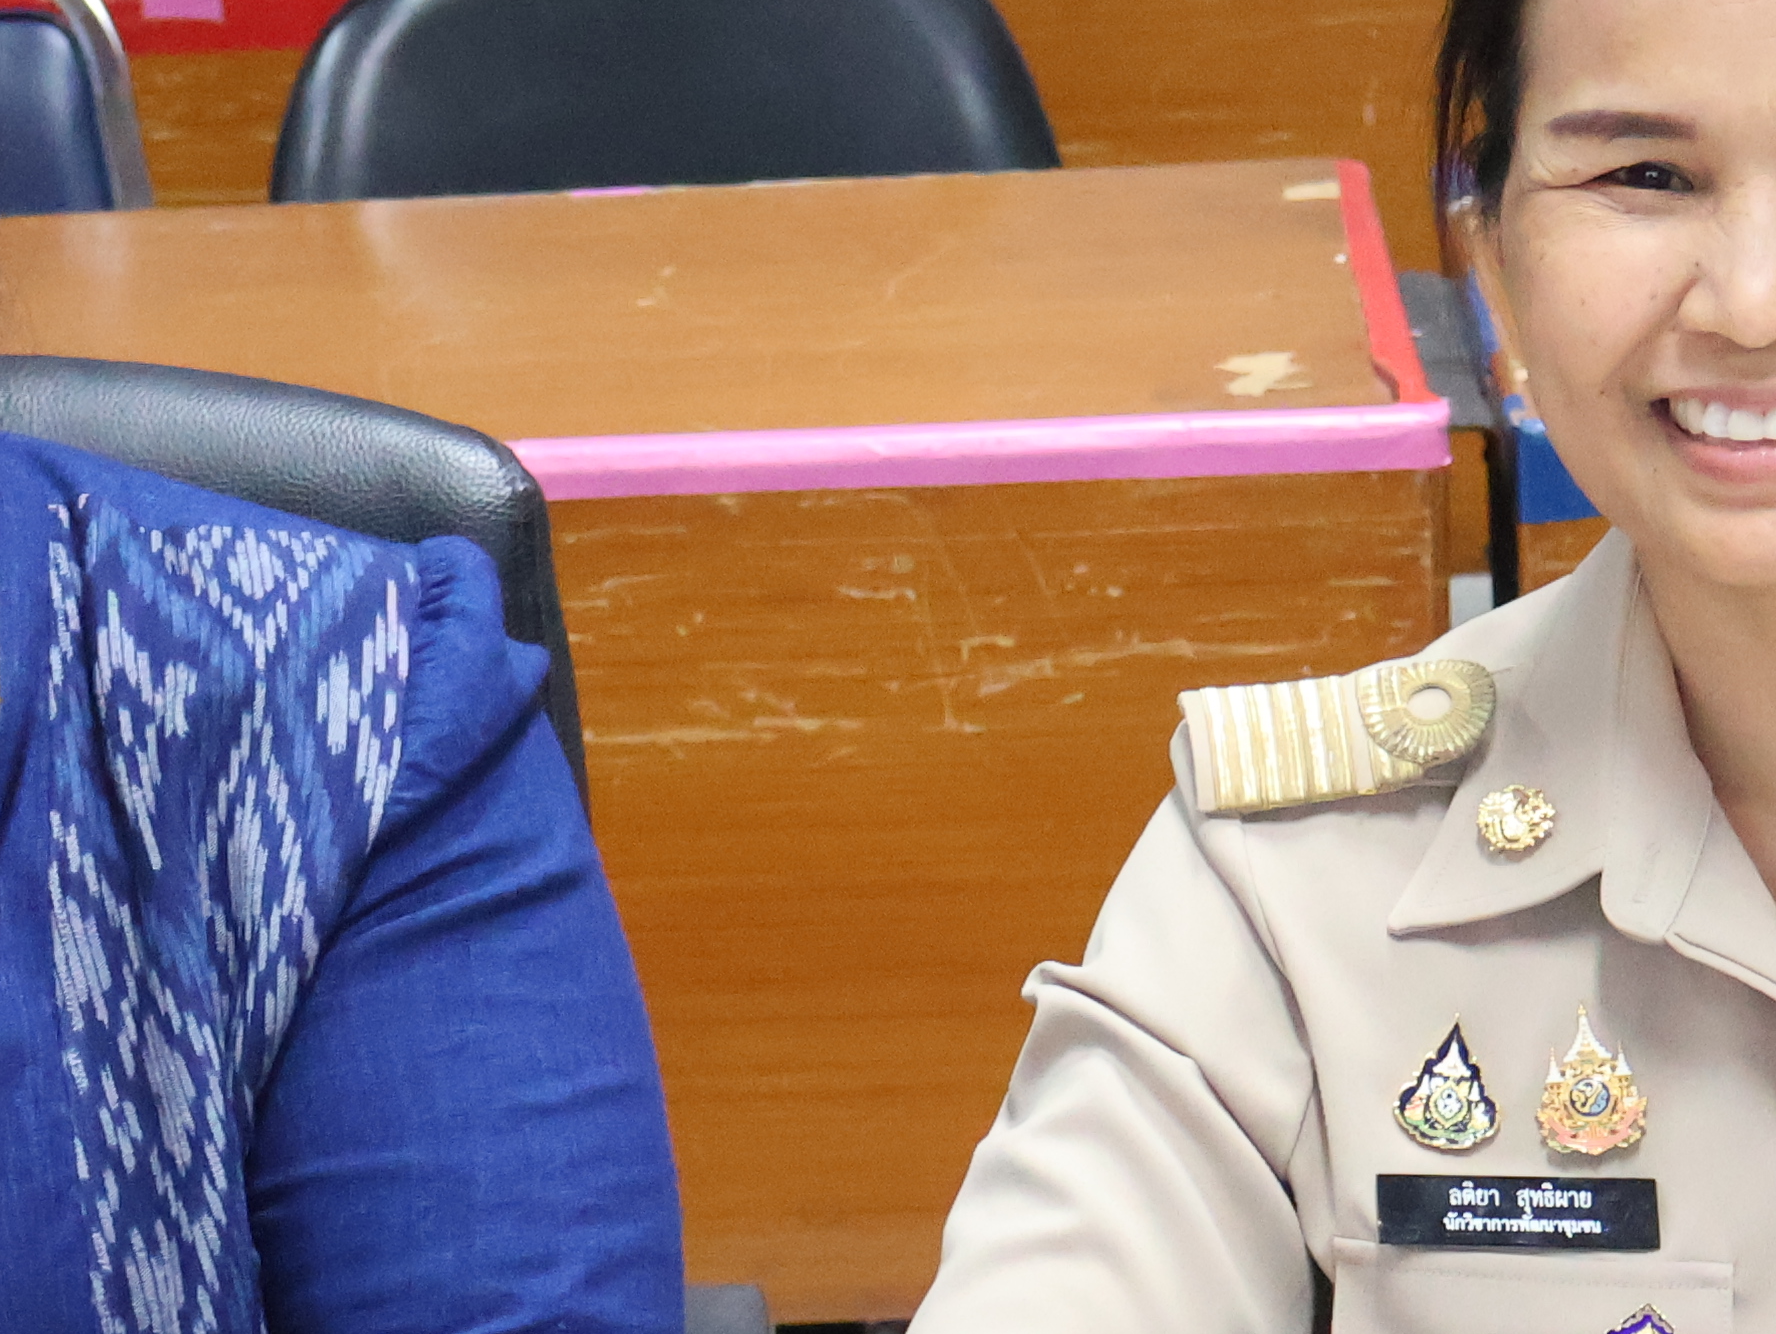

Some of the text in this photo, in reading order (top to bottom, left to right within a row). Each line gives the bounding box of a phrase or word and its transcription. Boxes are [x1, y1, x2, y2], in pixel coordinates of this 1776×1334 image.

[1442, 1211, 1602, 1238] นักวิชาการพัฒนาชุมชน
